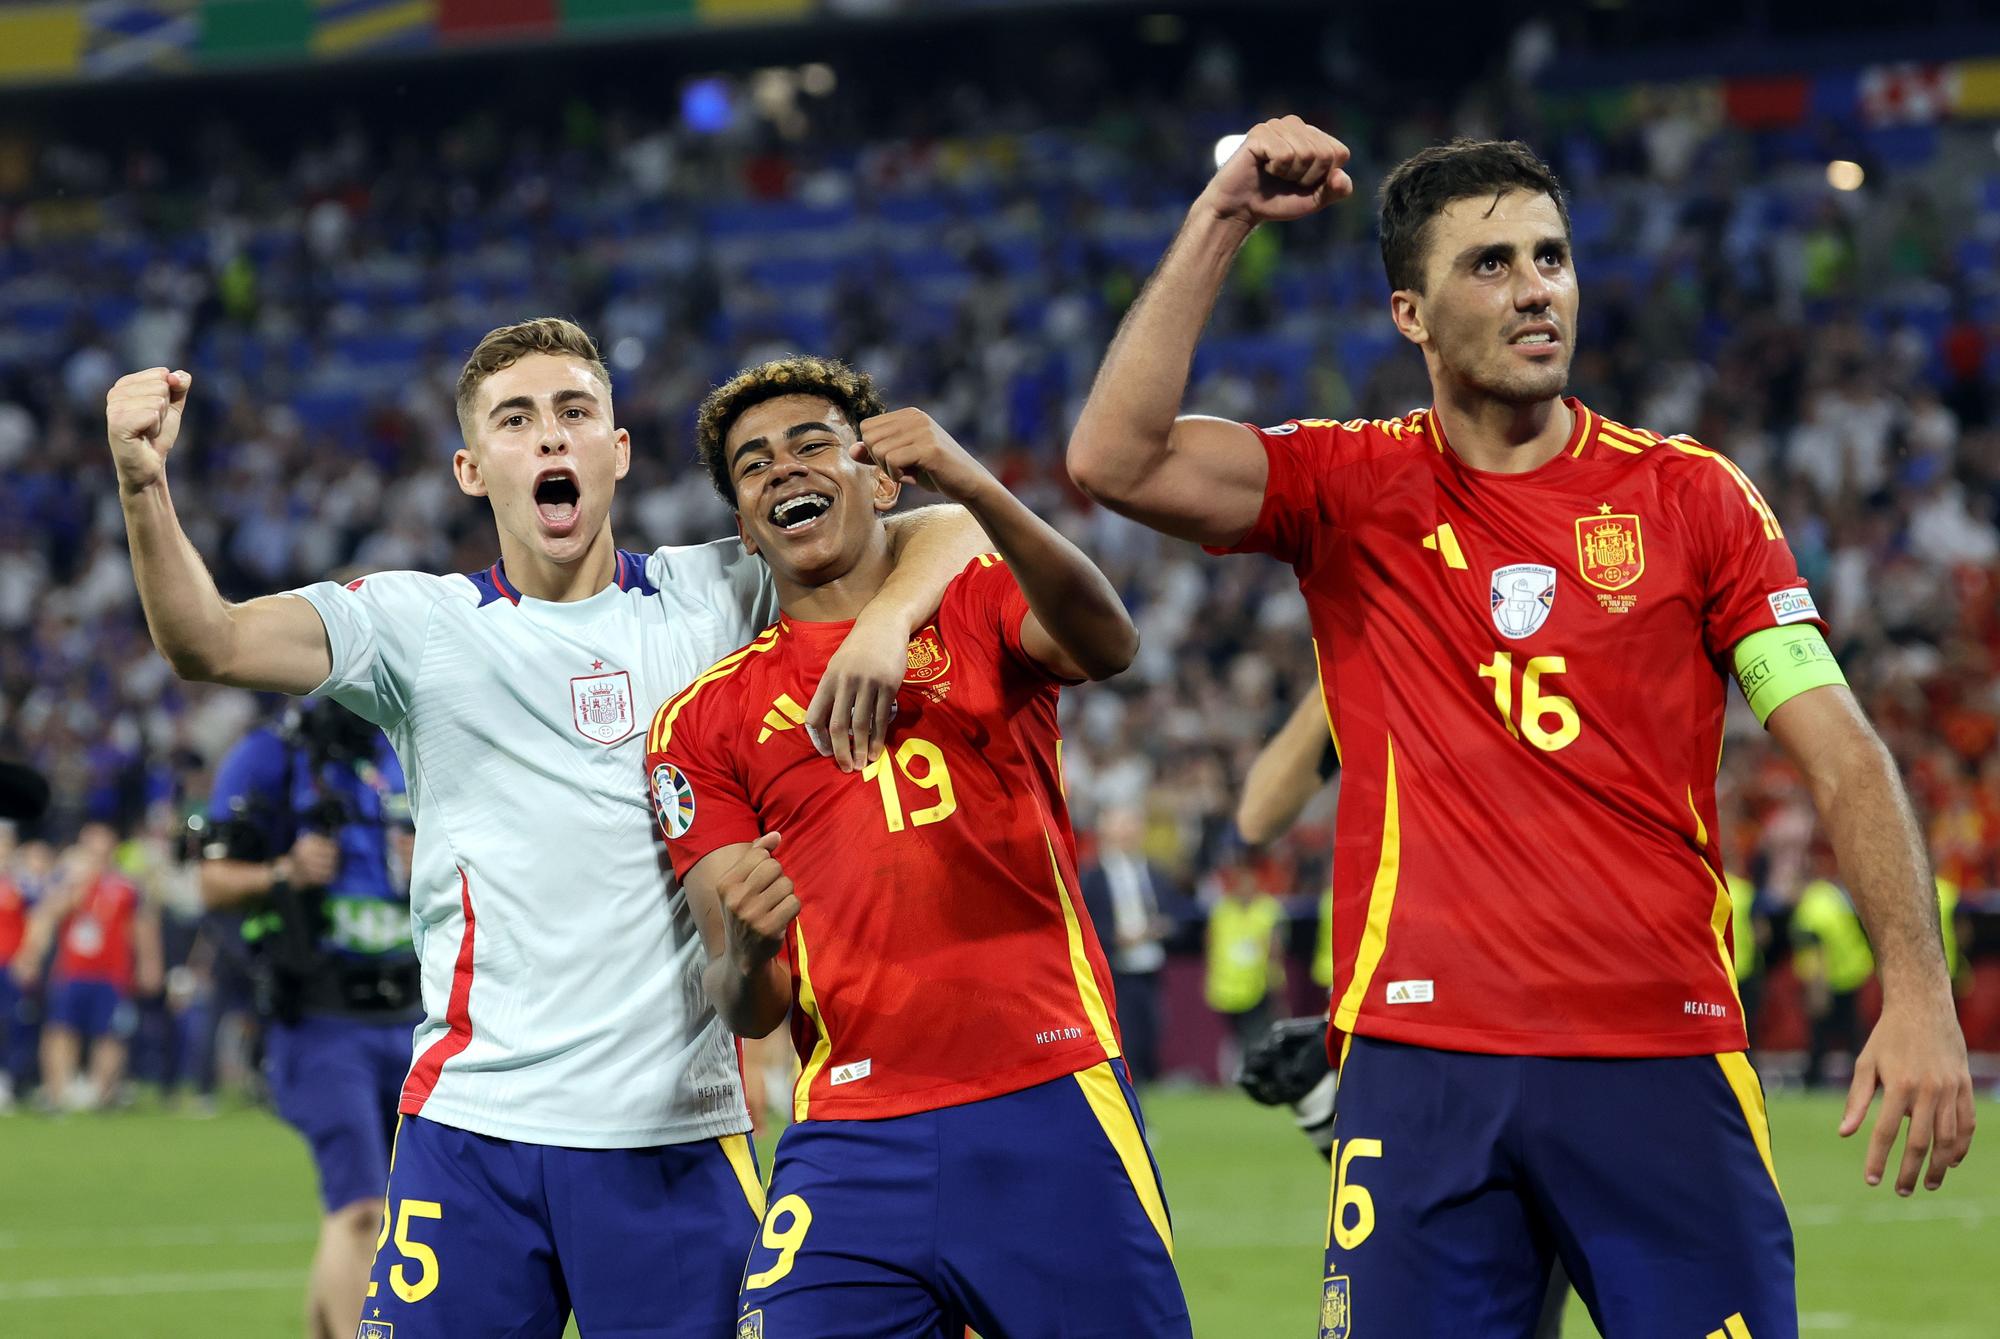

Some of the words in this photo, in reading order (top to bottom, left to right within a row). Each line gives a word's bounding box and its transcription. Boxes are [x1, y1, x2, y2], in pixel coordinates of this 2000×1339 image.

[1771, 592, 1791, 603] UEFA
[1478, 651, 1581, 752] 16
[861, 737, 957, 833] 19
[1684, 1000, 1726, 1018] HEAT.RDY
[1035, 1027, 1082, 1044] HEAT.RDY
